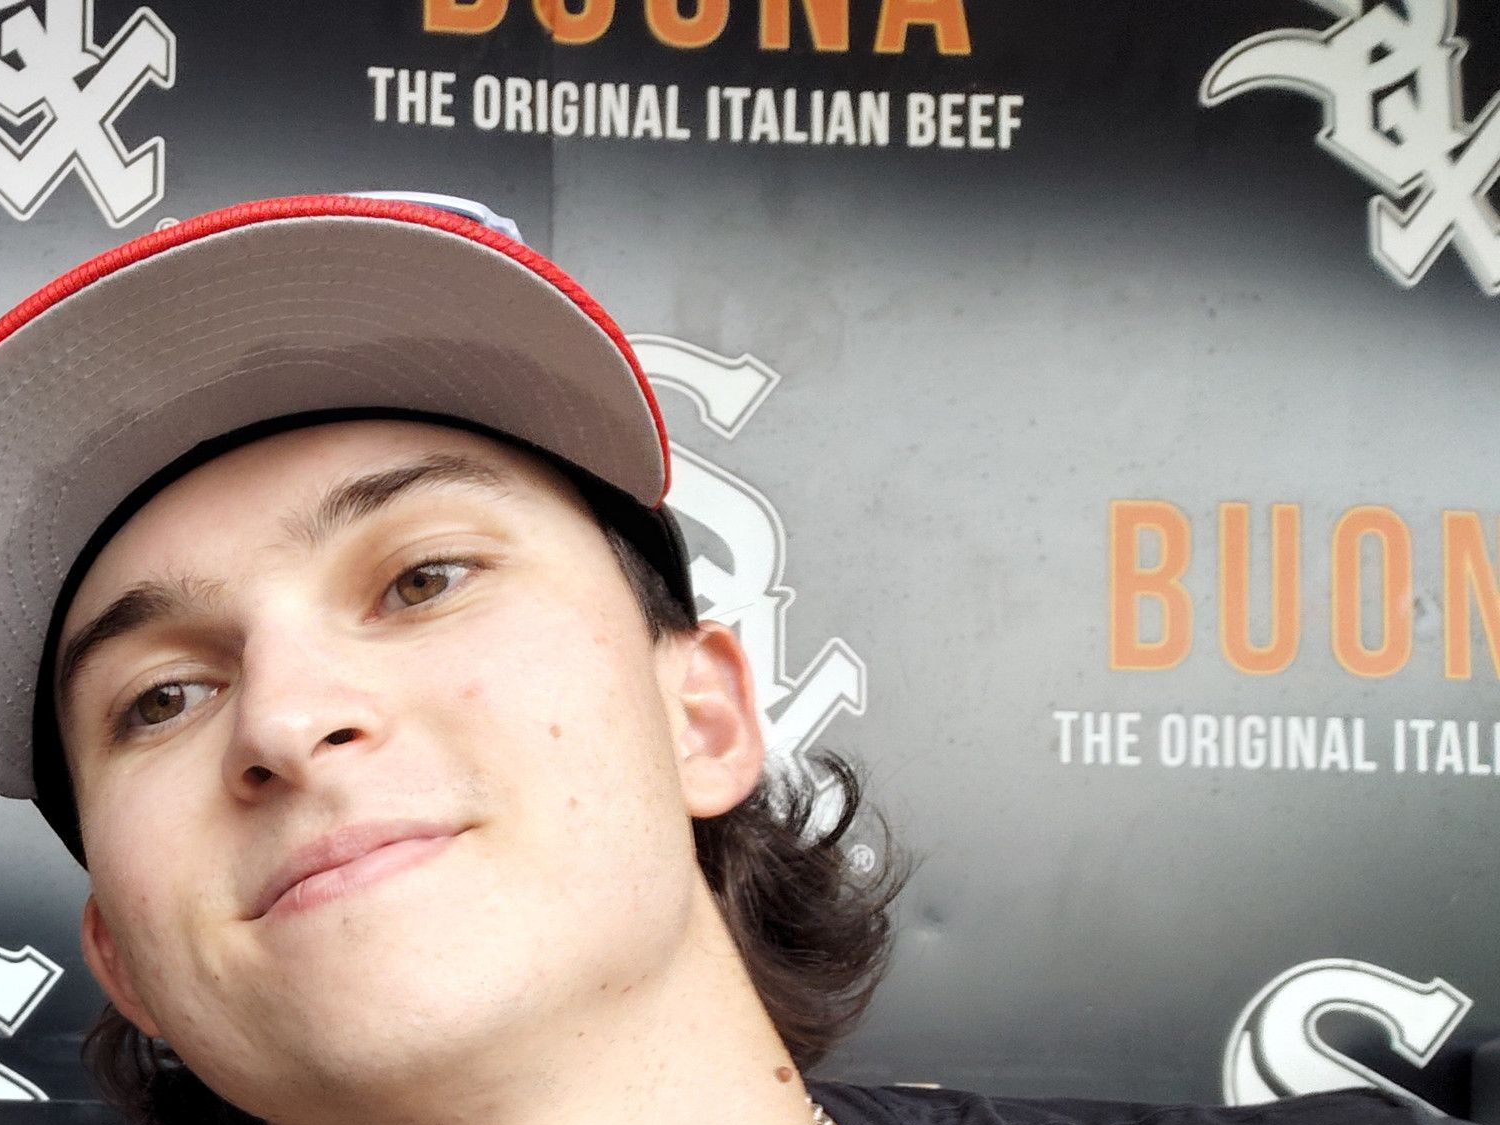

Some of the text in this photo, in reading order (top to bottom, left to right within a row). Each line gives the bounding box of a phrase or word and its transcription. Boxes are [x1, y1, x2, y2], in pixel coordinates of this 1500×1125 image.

[367, 66, 1024, 149] THE ORIGINAL ITALIAN BEEF
[1109, 498, 1500, 680] BUON
[1053, 710, 1142, 765] THE
[1159, 713, 1378, 772] ORIGINAL
